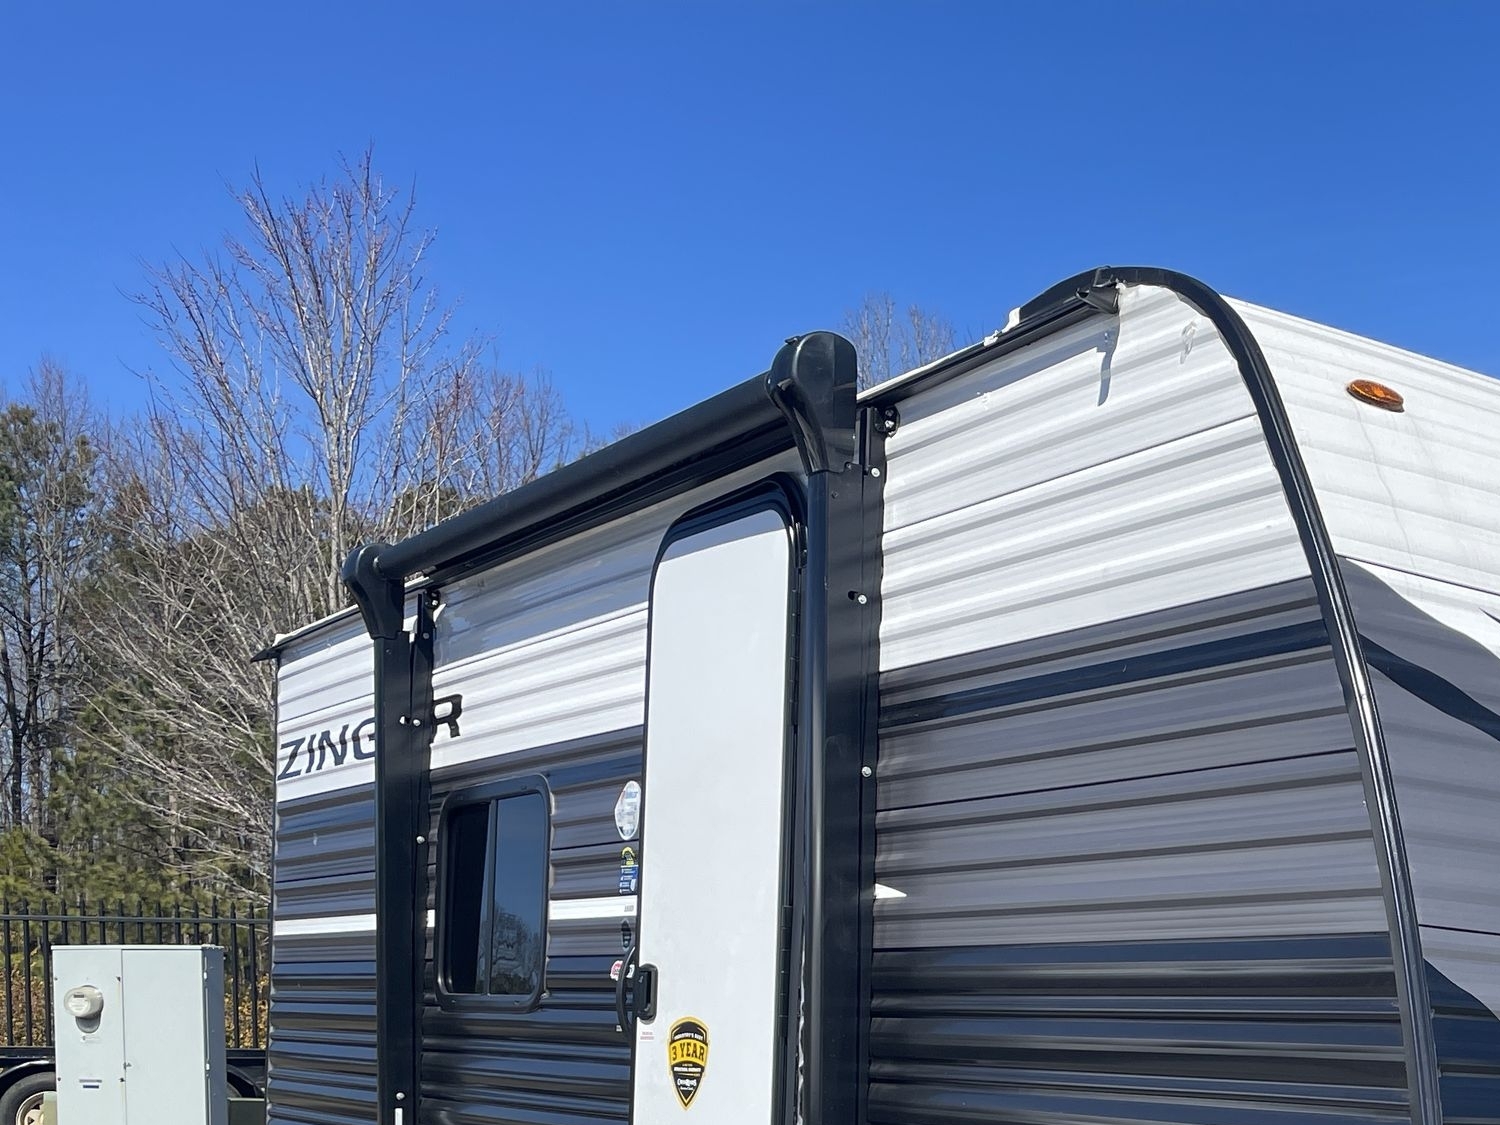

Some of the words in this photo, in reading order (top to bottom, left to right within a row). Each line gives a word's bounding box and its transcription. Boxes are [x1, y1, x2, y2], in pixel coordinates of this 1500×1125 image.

[277, 693, 463, 781] ZINGR
[672, 1046, 678, 1061] 3
[680, 1042, 705, 1061] YEAR
